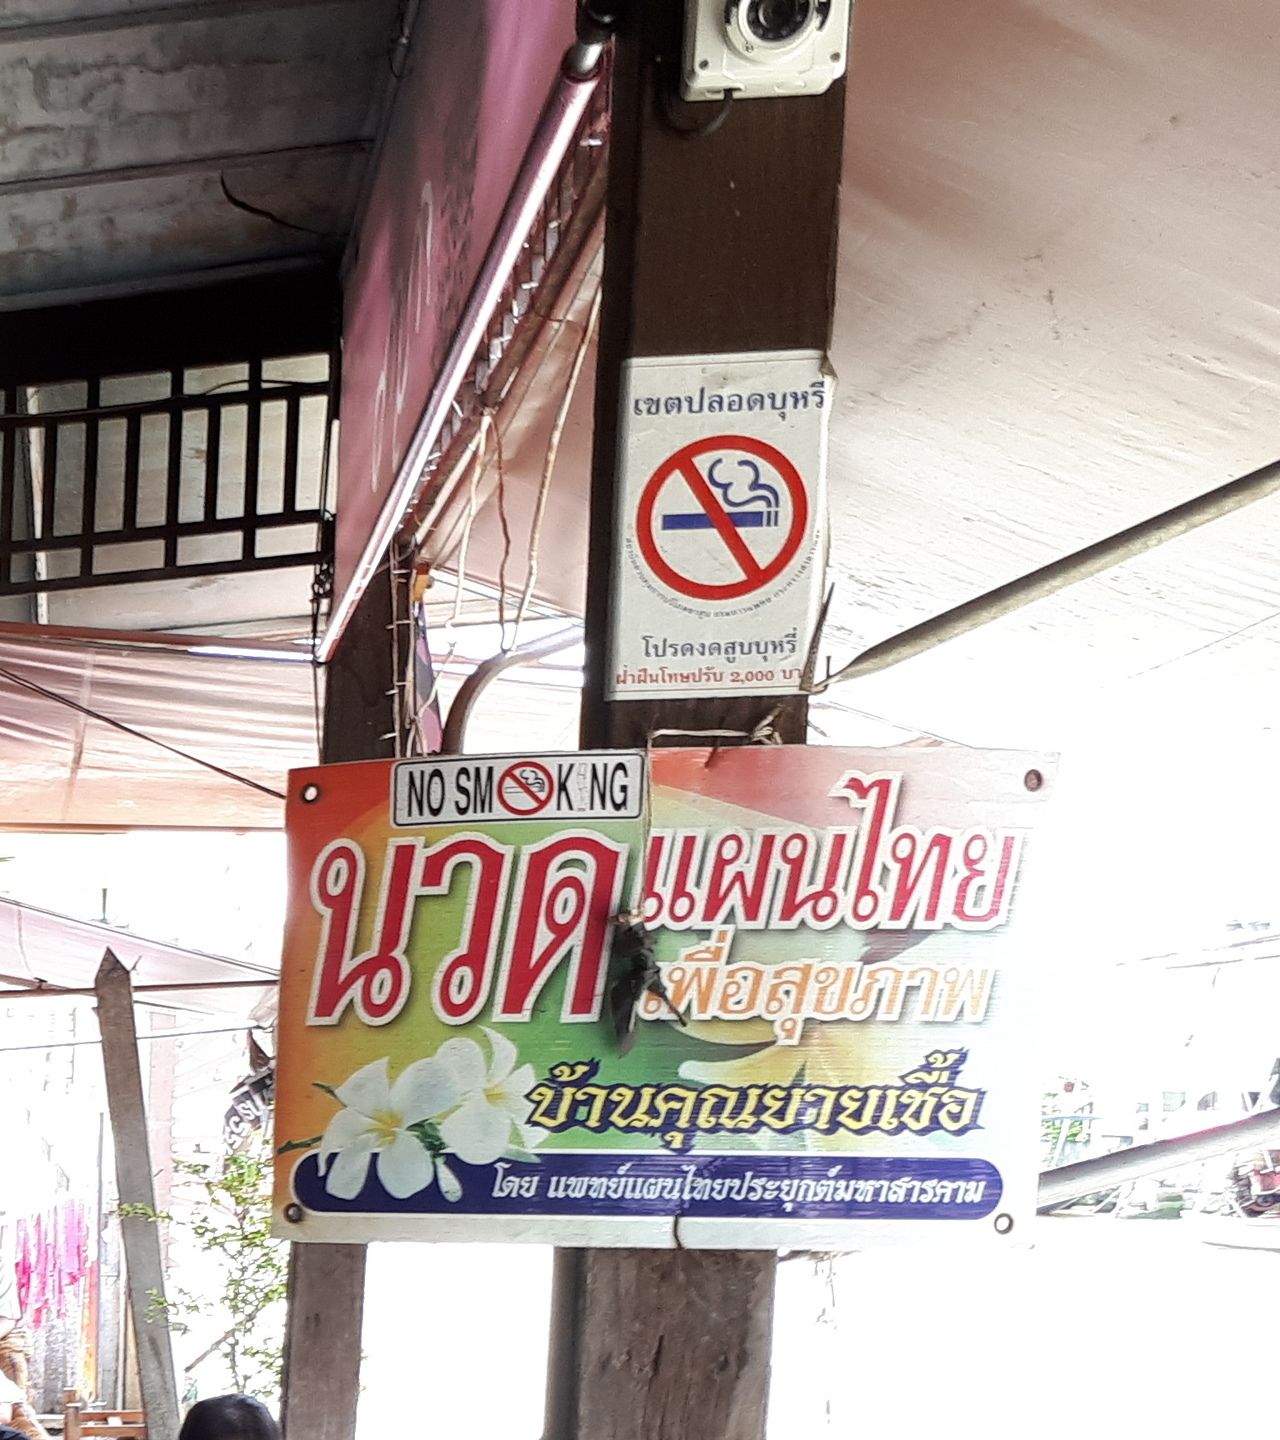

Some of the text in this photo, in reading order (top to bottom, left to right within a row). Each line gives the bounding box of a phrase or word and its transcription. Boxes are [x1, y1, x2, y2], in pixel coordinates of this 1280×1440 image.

[641, 627, 798, 664] โปรดงดสูบบุหรี่
[729, 670, 775, 685] 2,000
[782, 667, 805, 681] บา
[406, 768, 446, 818] NO
[308, 775, 1017, 1022] นวด แผนไทย
[530, 1051, 980, 1150] บ้านคุณยายเชื้อ
[490, 1161, 538, 1199] โดย
